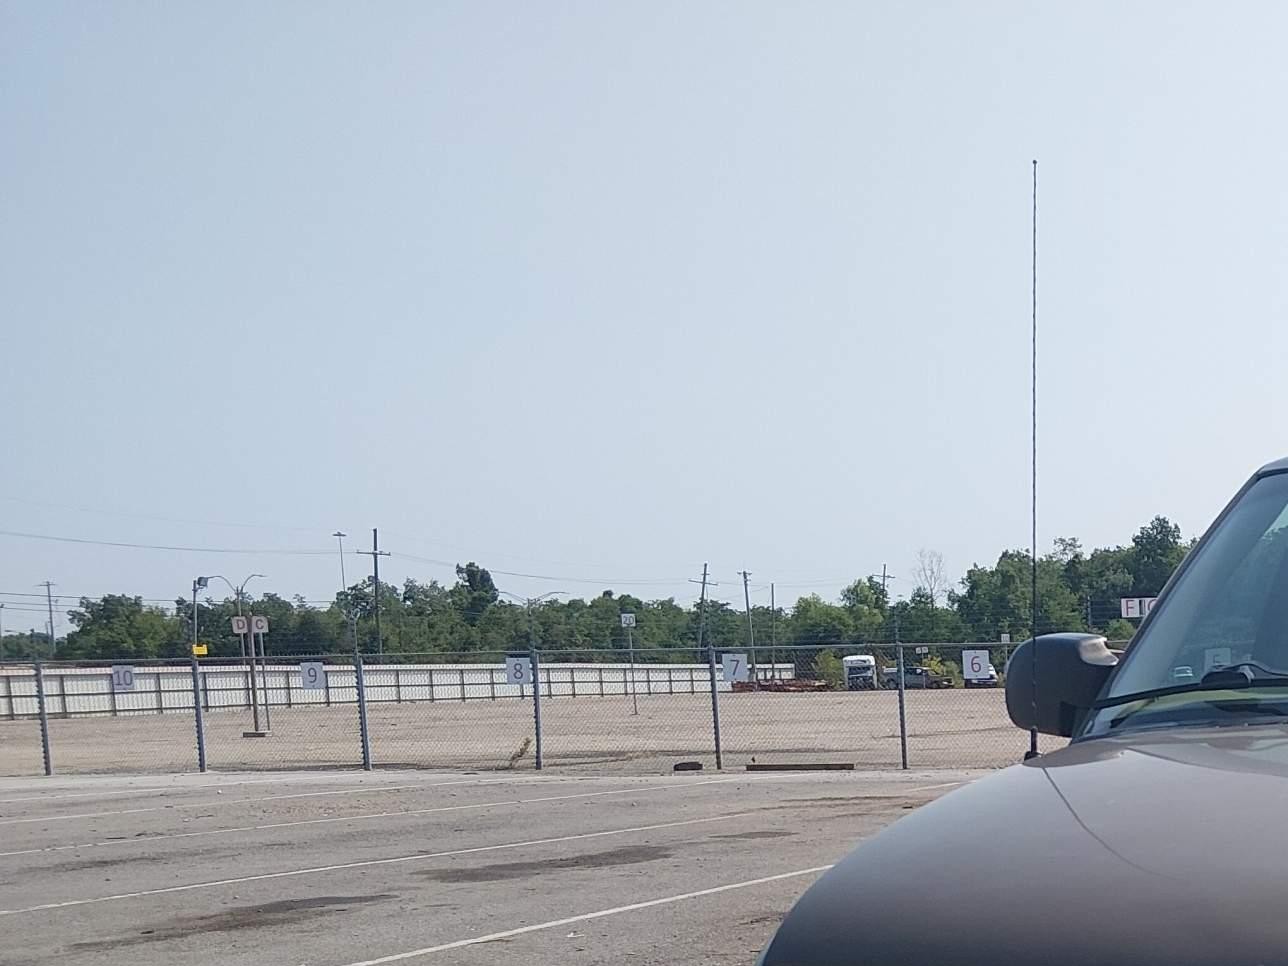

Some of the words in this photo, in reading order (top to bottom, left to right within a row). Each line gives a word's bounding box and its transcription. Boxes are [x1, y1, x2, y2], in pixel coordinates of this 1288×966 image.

[1125, 599, 1135, 617] F
[236, 619, 246, 630] D
[255, 618, 265, 630] C
[513, 662, 524, 680] 8
[729, 659, 740, 676] 7
[970, 655, 982, 673] 6
[113, 670, 133, 686] 10
[307, 667, 317, 684] 9
